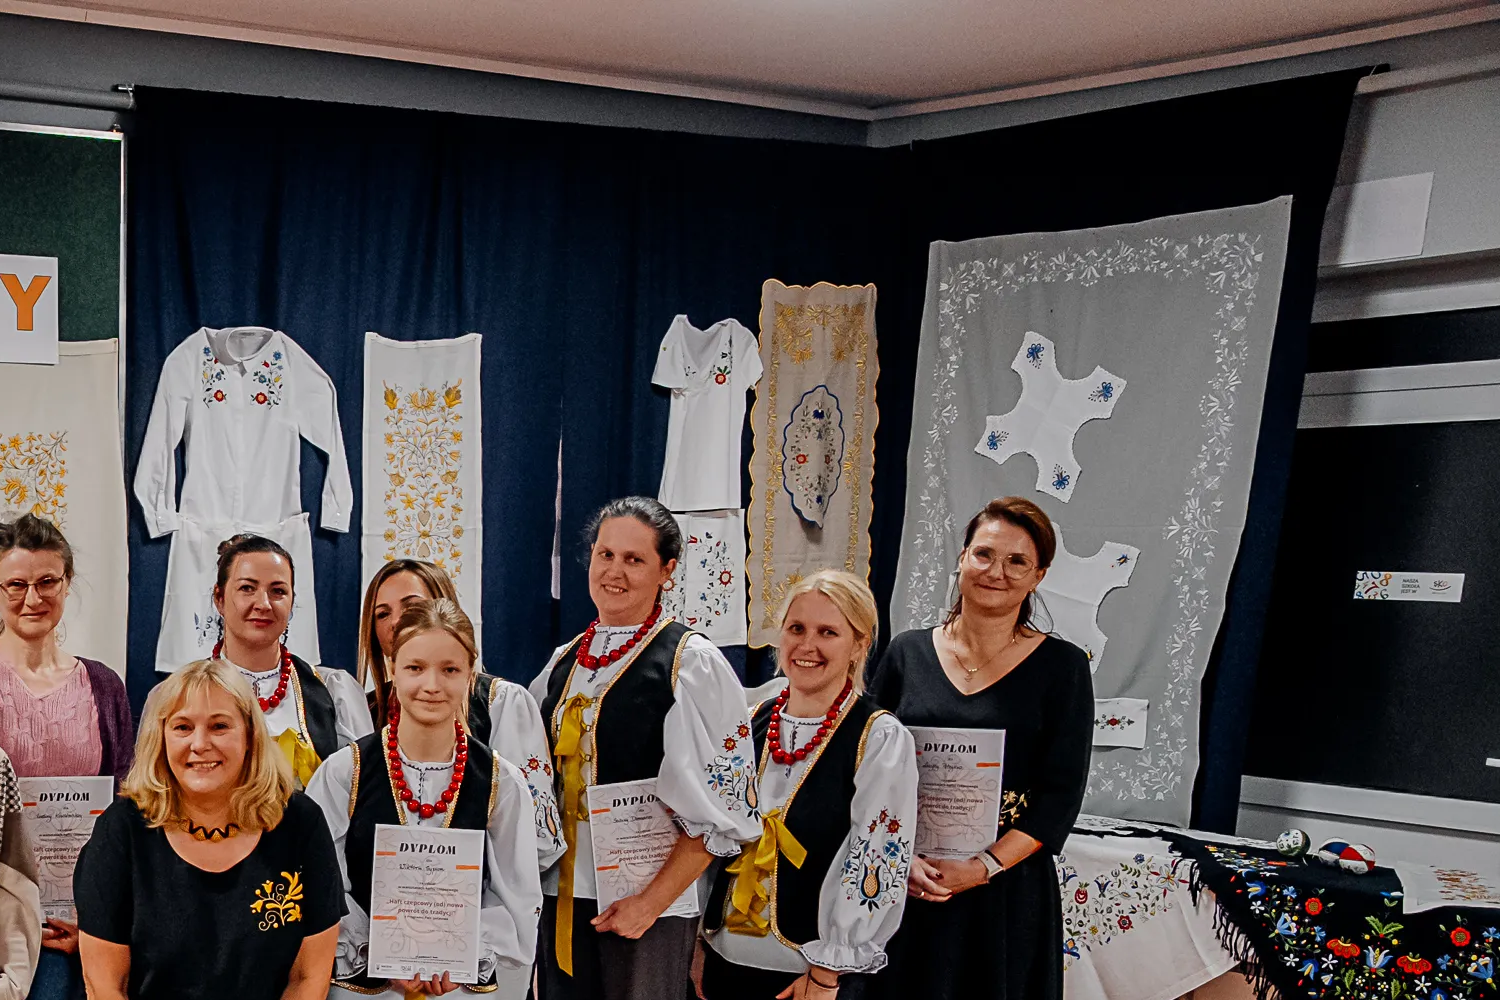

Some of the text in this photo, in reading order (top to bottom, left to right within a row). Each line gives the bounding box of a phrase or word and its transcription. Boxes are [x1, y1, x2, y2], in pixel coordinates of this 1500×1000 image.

[923, 742, 977, 753] DYPLOM
[39, 792, 90, 802] DYPLOM
[399, 842, 456, 855] DYPLOM
[404, 900, 433, 908] czepcowy
